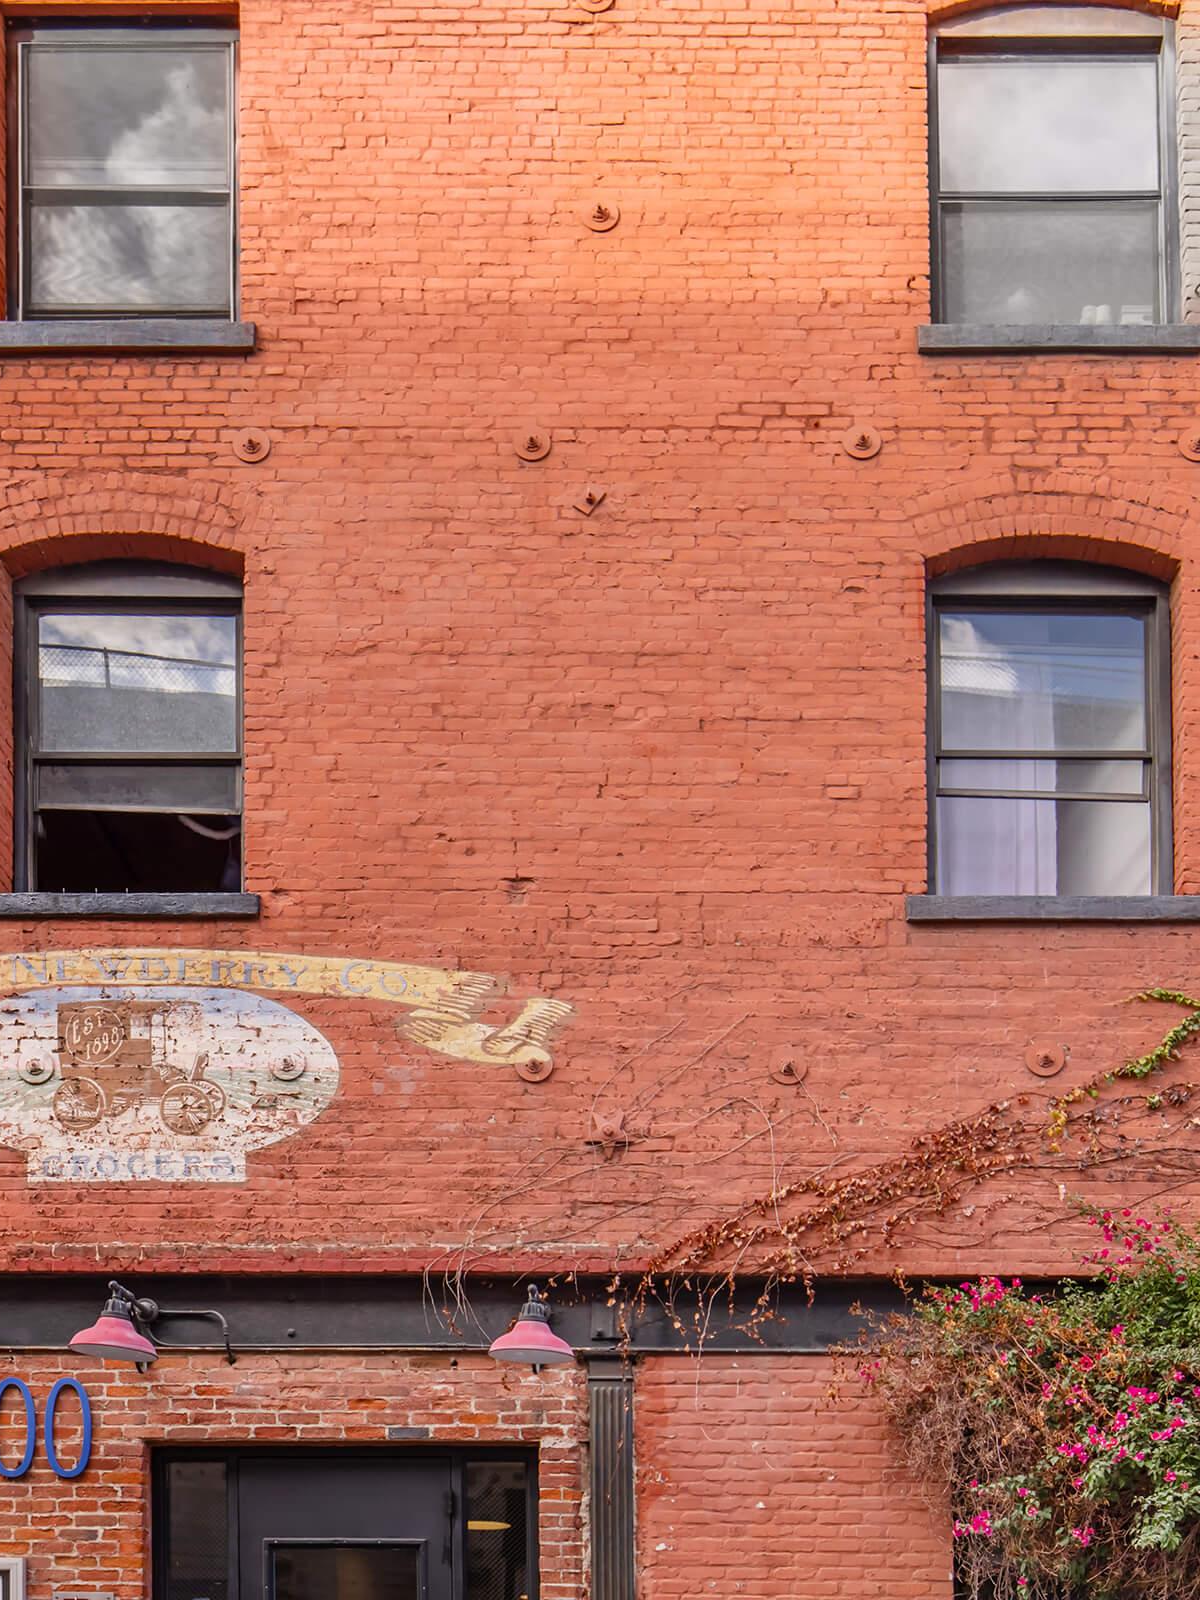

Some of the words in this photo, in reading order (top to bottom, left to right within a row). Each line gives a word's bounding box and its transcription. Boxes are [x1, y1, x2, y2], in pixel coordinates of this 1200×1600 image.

[10, 951, 308, 988] NEWBERRY
[85, 1026, 120, 1060] 1898
[42, 1154, 237, 1178] GROCERS
